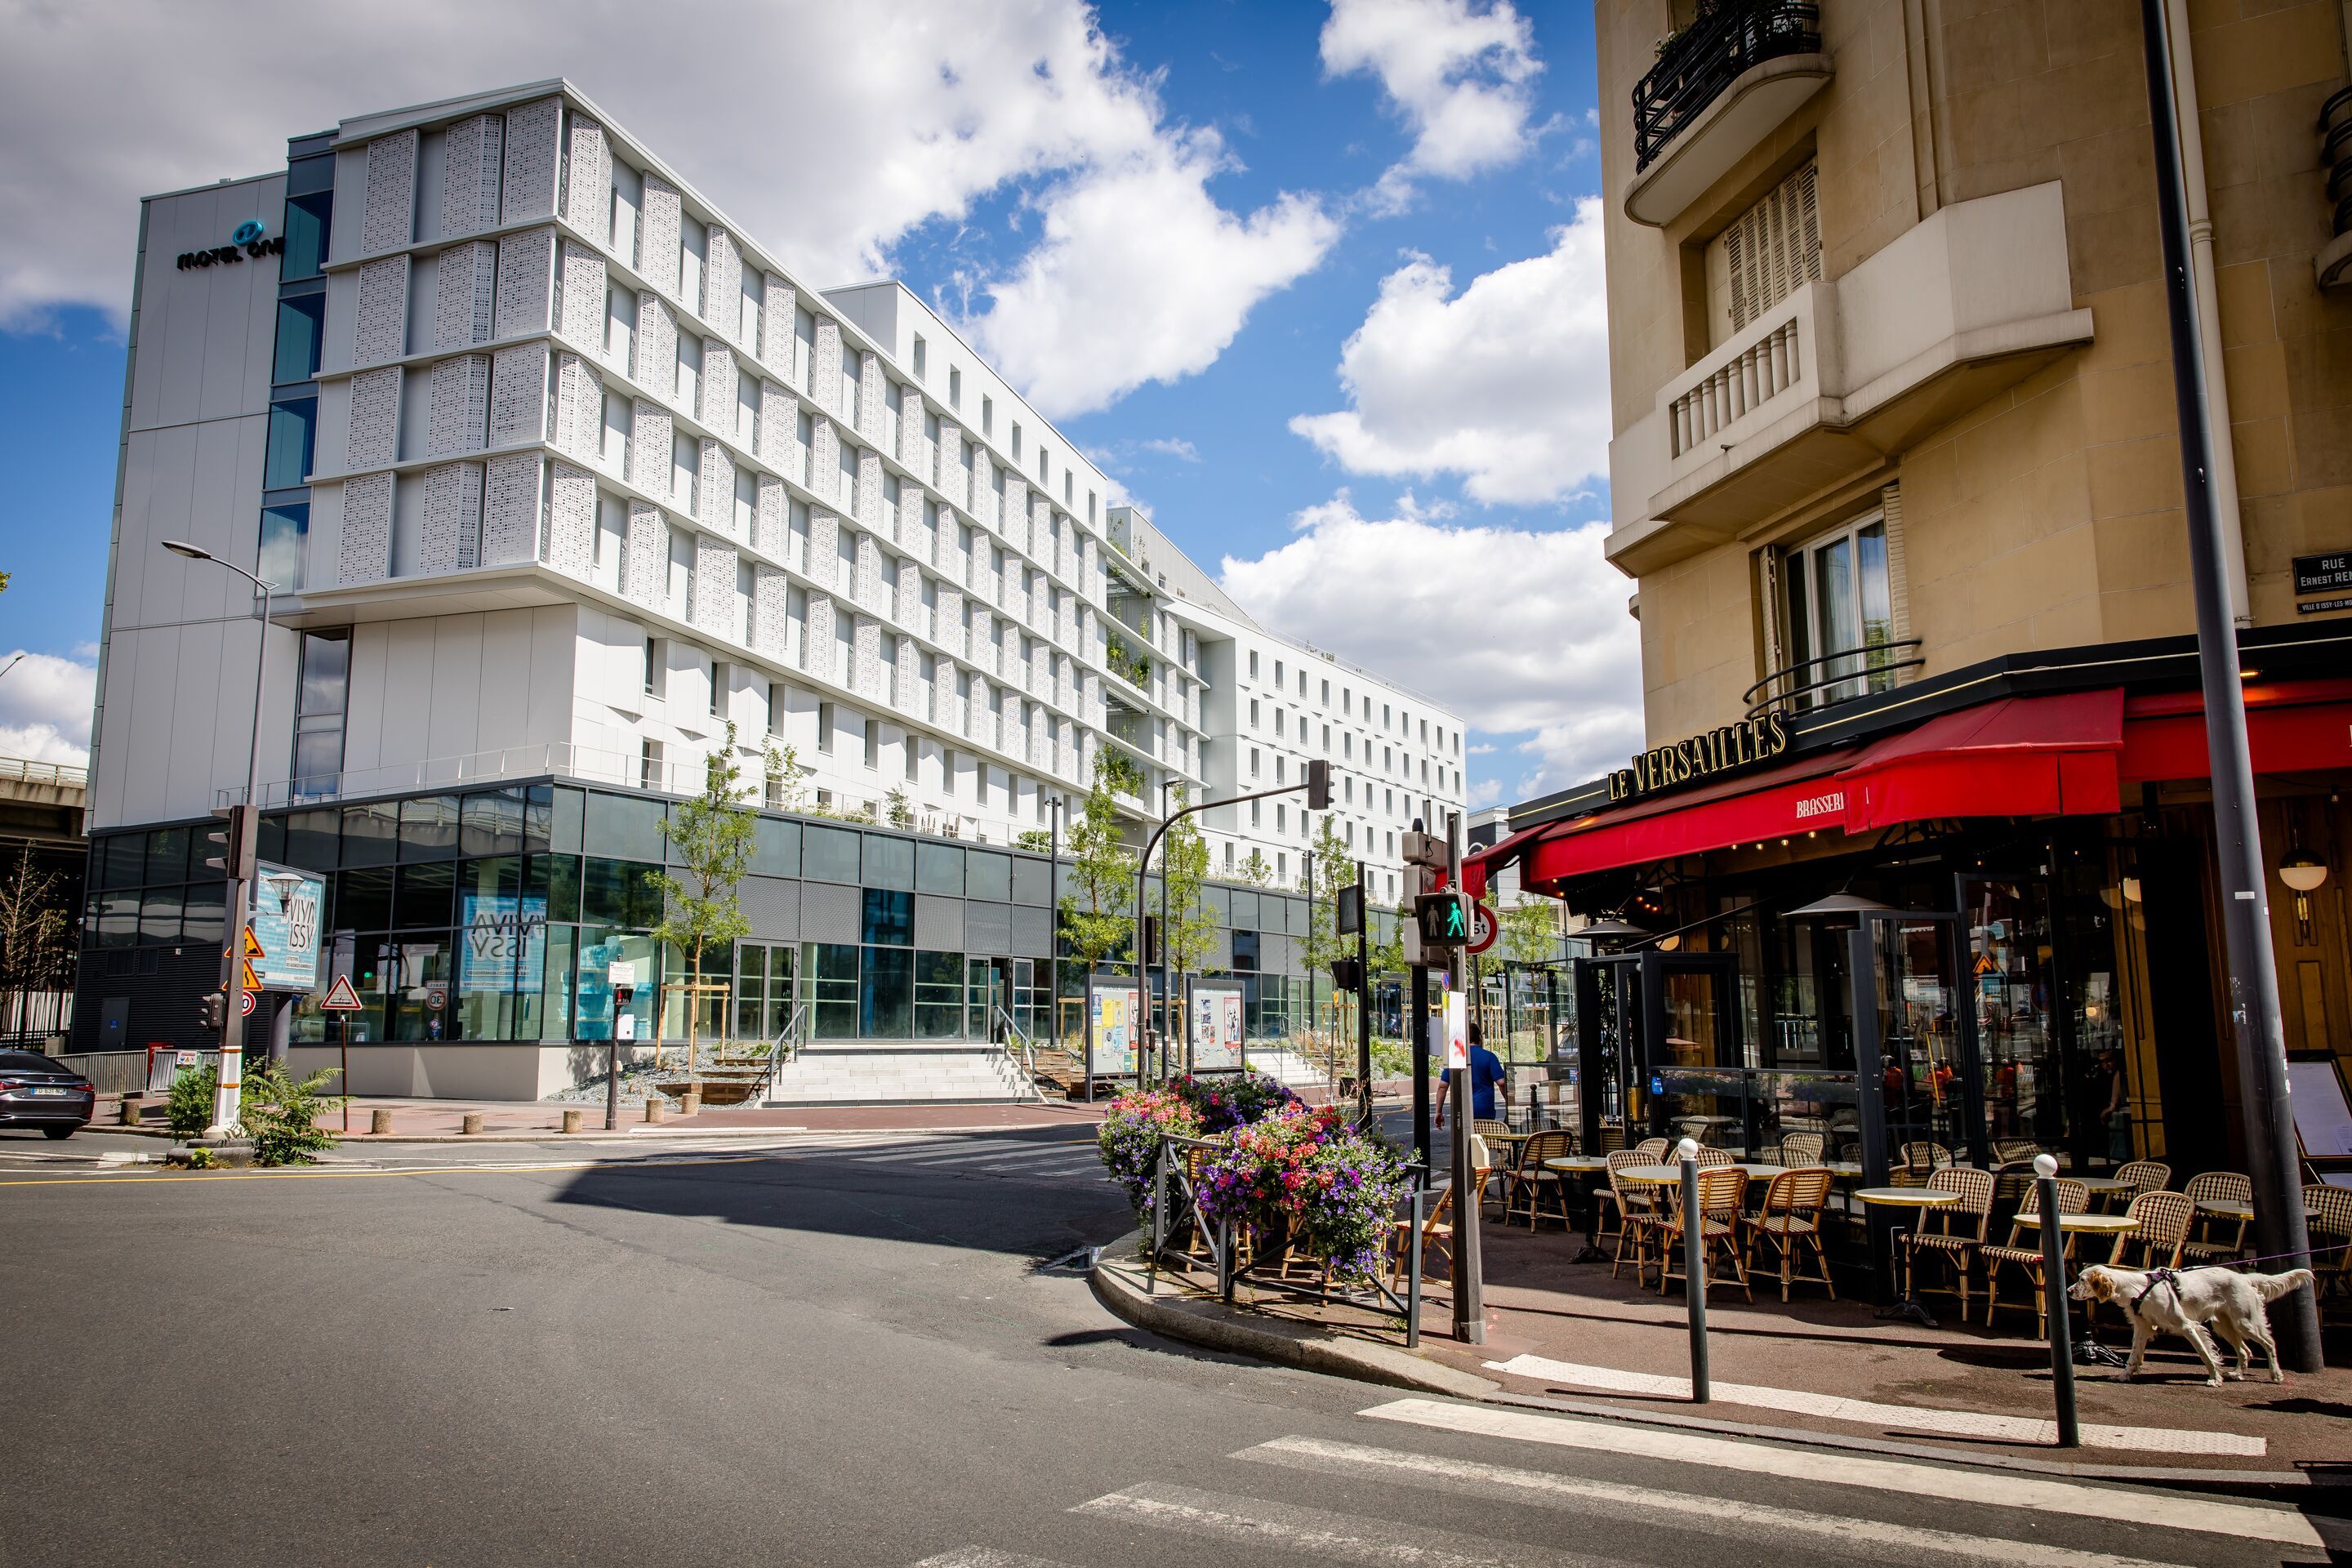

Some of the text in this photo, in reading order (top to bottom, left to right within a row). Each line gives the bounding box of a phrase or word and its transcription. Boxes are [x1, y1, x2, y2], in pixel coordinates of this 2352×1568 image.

[2322, 558, 2345, 570] RUE
[1608, 710, 1787, 800] LE VERSAILLES
[289, 924, 314, 950] ISSY
